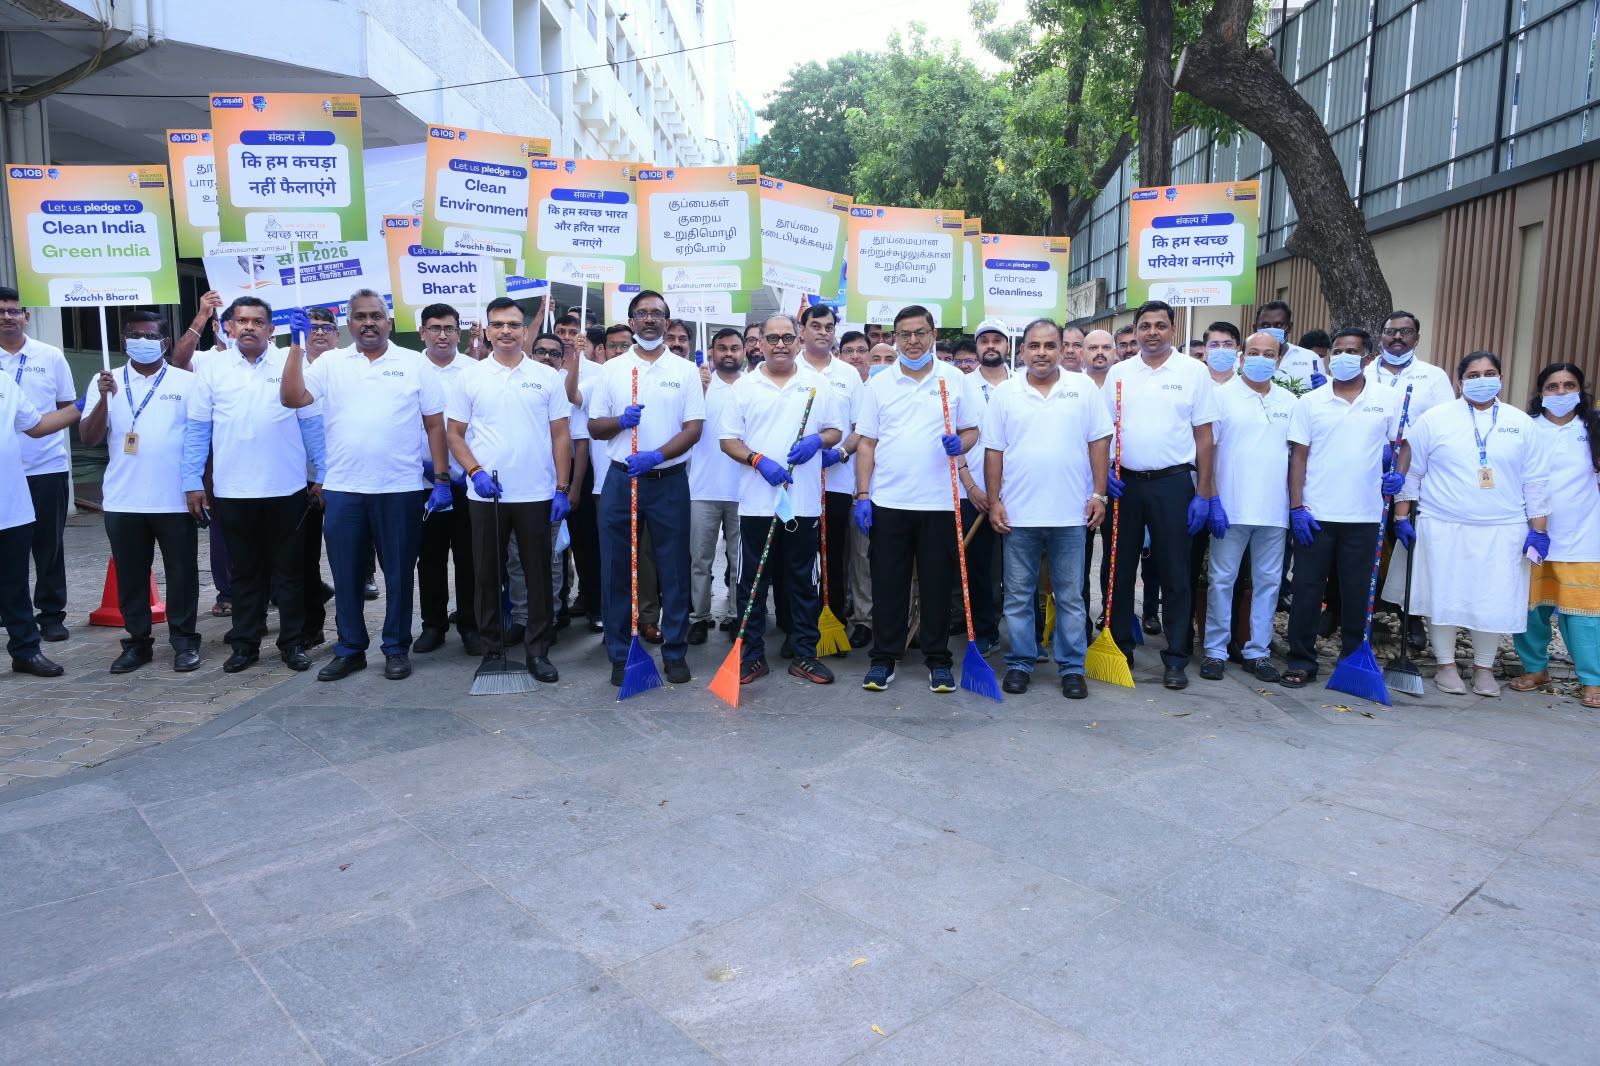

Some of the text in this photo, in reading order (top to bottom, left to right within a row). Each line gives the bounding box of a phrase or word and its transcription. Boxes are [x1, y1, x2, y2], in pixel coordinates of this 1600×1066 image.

[268, 132, 306, 142] संकल्प लें
[440, 130, 454, 138] IOB
[241, 151, 337, 173] कि हम कचड़ा
[24, 169, 43, 177] IOB
[454, 161, 468, 170] Let
[481, 166, 510, 177] pledge
[512, 169, 522, 177] to
[249, 177, 336, 197] नहीं फैलाएंगे
[465, 178, 507, 195] Clean
[573, 190, 605, 200] संकल्प लें
[48, 203, 66, 212] Let
[84, 202, 121, 214] pledge
[124, 204, 136, 212] to
[440, 195, 528, 218] Environment
[668, 197, 730, 212] குப்பைகள்
[548, 204, 629, 219] कि हम स्वच्छ भारत
[678, 214, 722, 226] குறைய
[1175, 214, 1209, 225] संकल्प लें
[42, 220, 146, 235] Clean India
[554, 220, 620, 234] और हरित भारत
[267, 230, 318, 240] स्वच्छ भारत
[454, 241, 484, 251] Swachh
[485, 244, 512, 254] Bharat
[572, 237, 602, 249] बनाएंगे
[1151, 234, 1229, 250] कि हम स्वच्छ
[42, 243, 151, 258] Green India
[312, 246, 349, 261] 2026
[413, 247, 426, 255] Let
[1148, 252, 1235, 269] परिवेश बनाएंगे
[417, 260, 478, 274] Swachh
[994, 274, 1036, 283] Embrace
[422, 282, 477, 295] Bharat
[989, 287, 1043, 298] Cleanliness
[64, 292, 139, 302] Swachh Bharat
[1189, 296, 1210, 304] भारत
[530, 382, 542, 390] IOB
[668, 381, 681, 389] IOB
